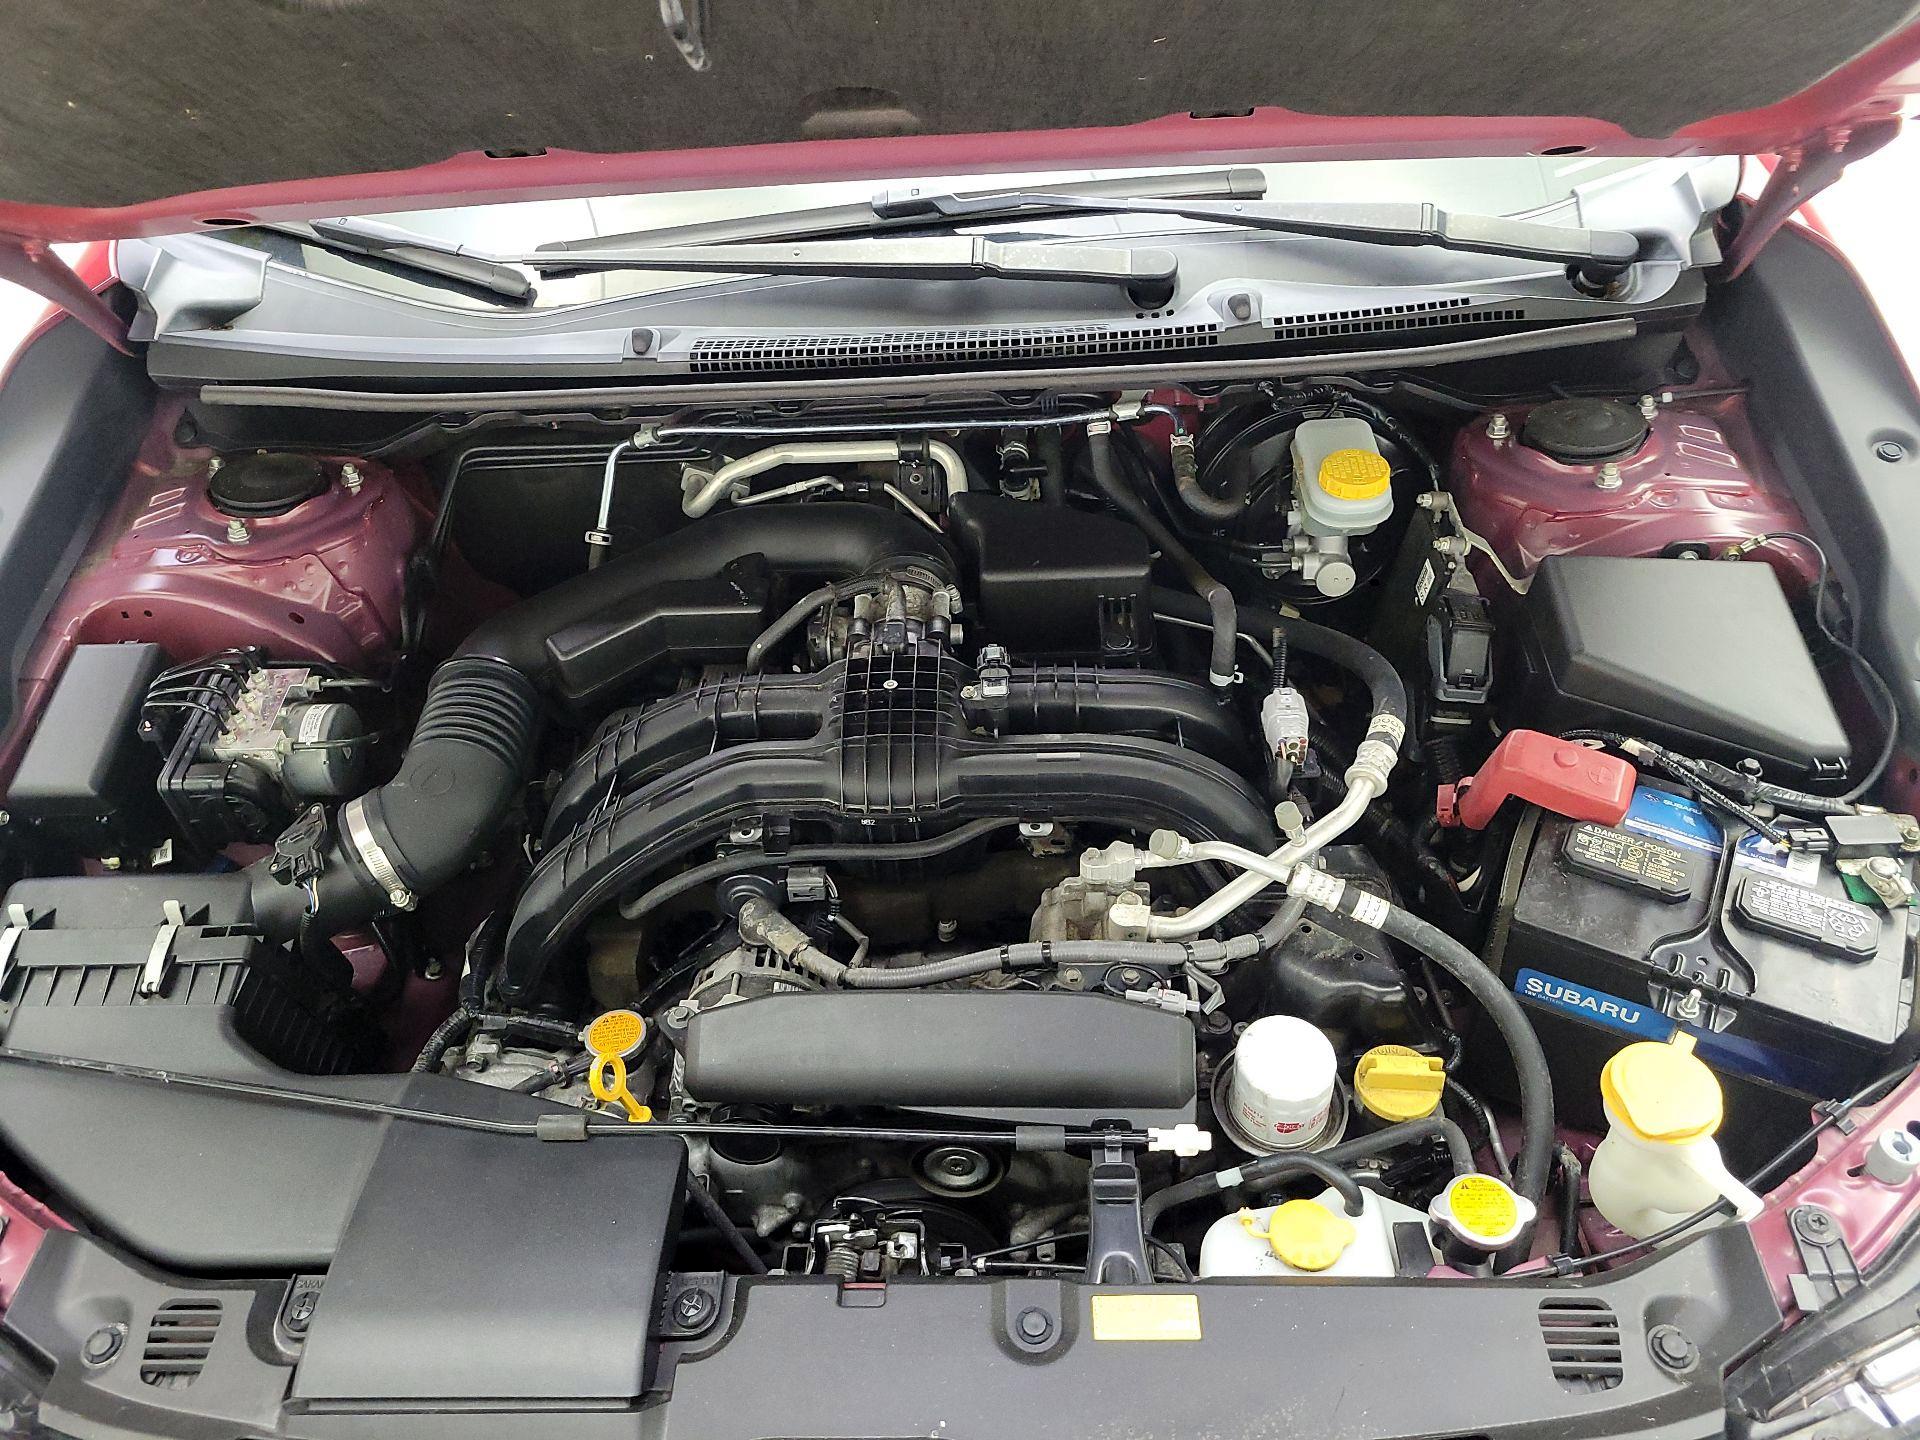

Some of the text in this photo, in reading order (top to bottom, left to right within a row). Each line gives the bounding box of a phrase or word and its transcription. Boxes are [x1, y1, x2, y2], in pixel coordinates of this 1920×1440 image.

[1663, 799, 1702, 815] SUBARU
[1593, 827, 1635, 845] DANGER
[1643, 842, 1681, 859] POISON
[1526, 977, 1640, 1023] SUBARU
